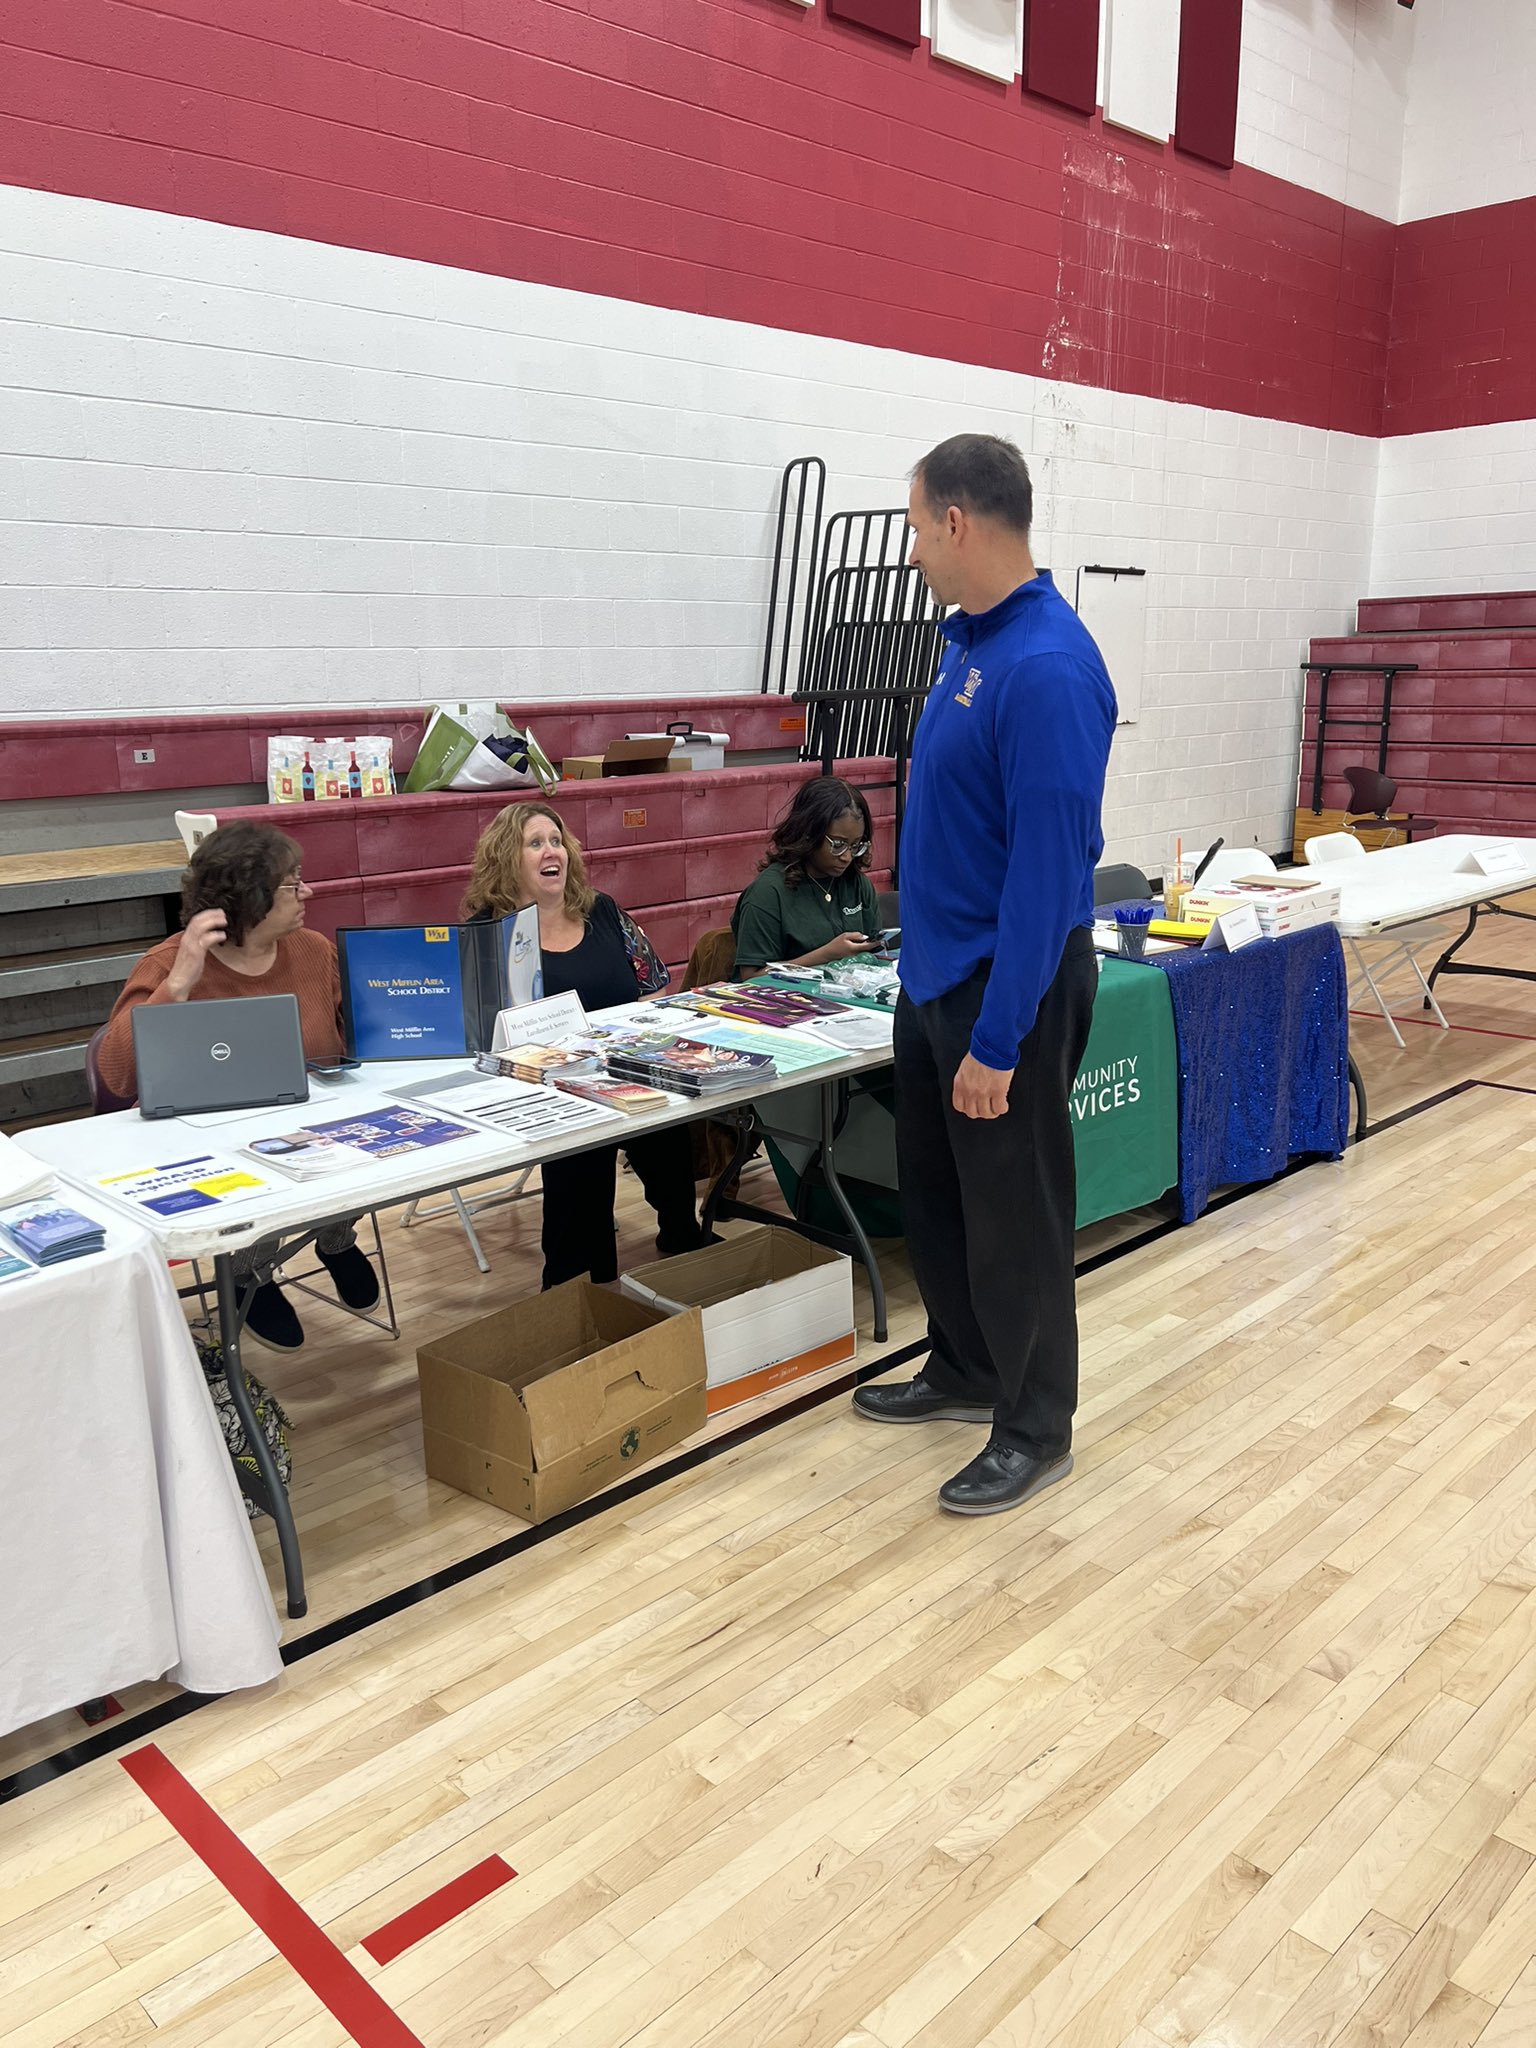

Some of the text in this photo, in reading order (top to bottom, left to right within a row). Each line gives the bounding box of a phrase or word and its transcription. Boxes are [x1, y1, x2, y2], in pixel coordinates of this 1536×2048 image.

[142, 752, 148, 760] E
[427, 929, 446, 939] WM
[368, 977, 444, 987] WEST MIFFLIN AREA
[387, 986, 450, 996] SCHOOL DISTRICT
[1068, 1078, 1141, 1123] VICES
[122, 1167, 235, 1195] Registration
[135, 1168, 206, 1185] WMASD
